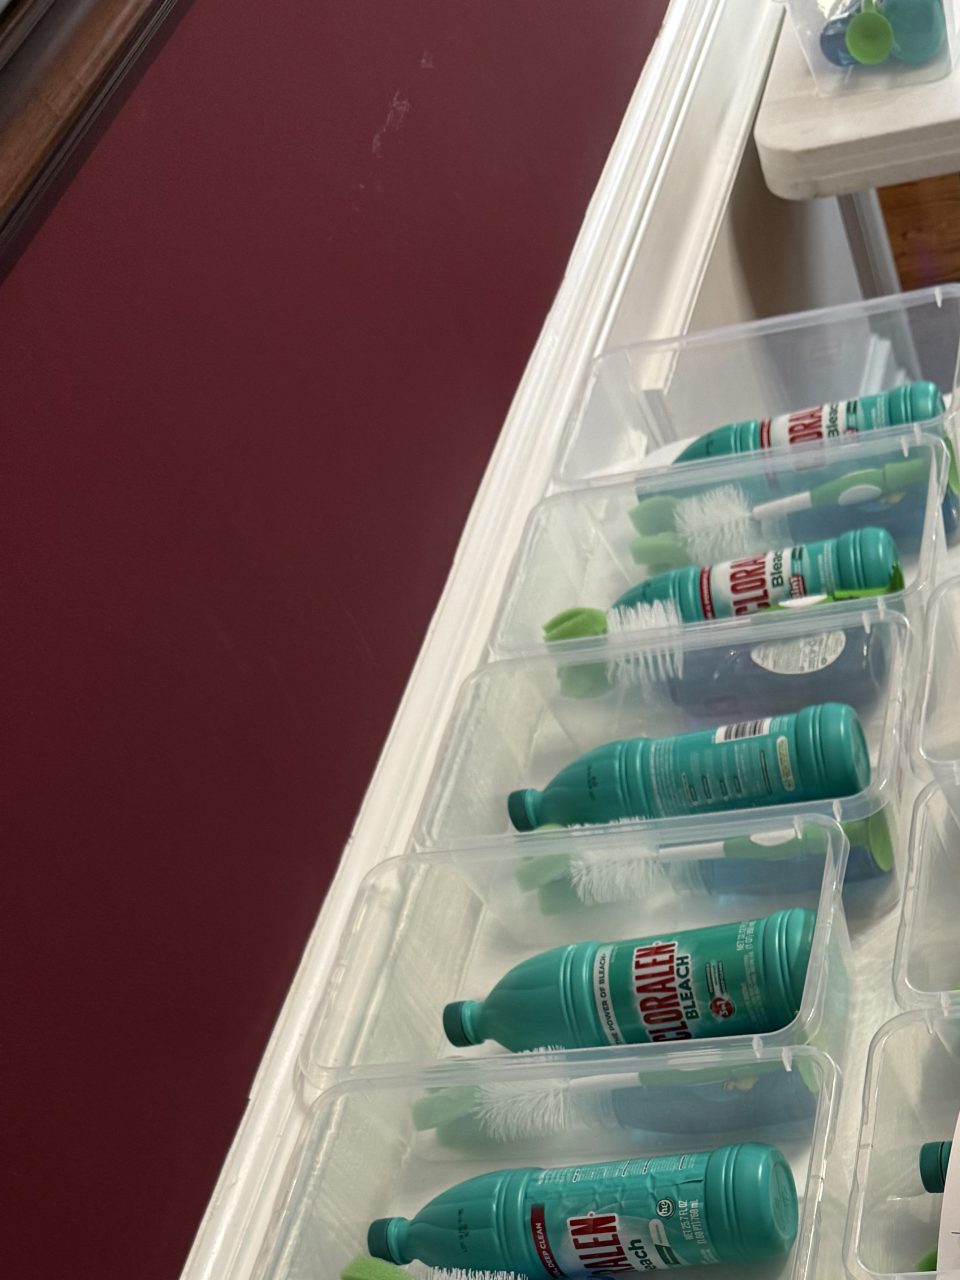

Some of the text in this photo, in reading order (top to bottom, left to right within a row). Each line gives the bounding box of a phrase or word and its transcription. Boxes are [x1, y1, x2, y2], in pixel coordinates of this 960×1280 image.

[600, 987, 607, 998] OF
[676, 955, 699, 1020] BLEACH
[602, 1000, 615, 1031] POWER
[536, 1223, 546, 1250] CLEAN
[628, 1239, 656, 1271] each
